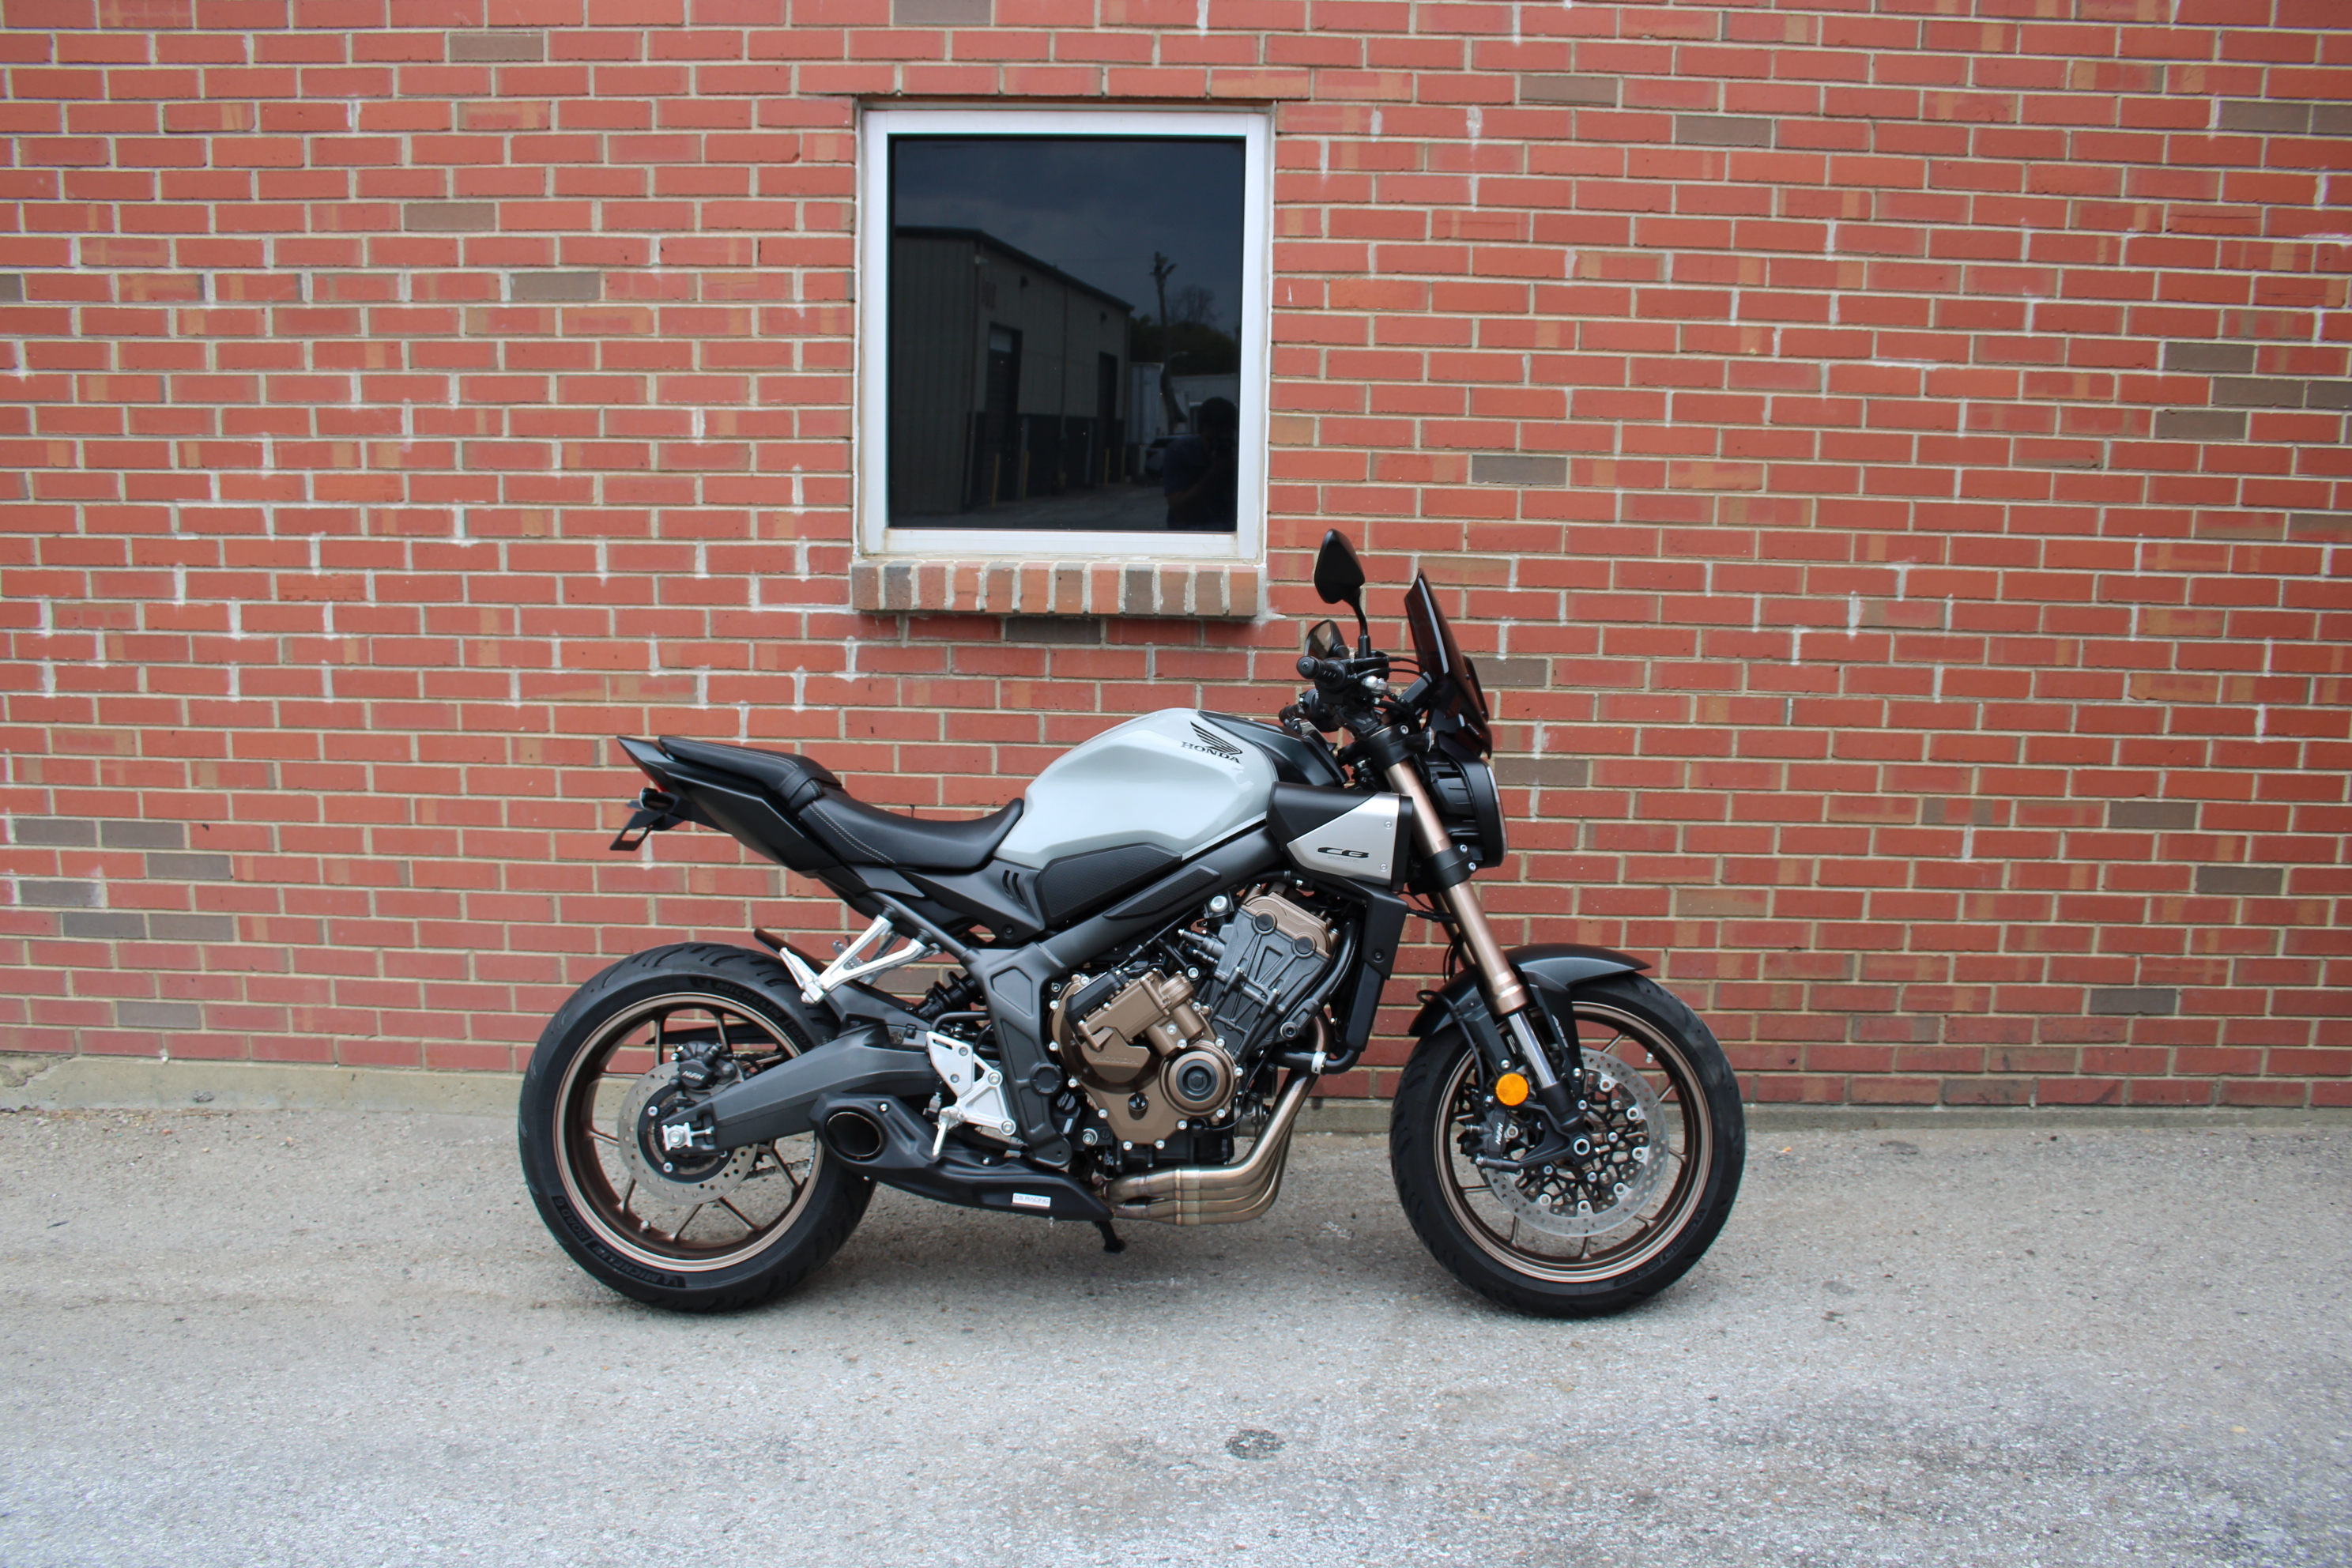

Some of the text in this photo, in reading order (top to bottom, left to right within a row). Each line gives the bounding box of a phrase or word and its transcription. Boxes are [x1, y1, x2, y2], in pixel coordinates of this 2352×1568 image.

[1181, 741, 1242, 764] HONDA
[1317, 846, 1370, 858] CB
[715, 981, 782, 1019] MICHELIN
[560, 1208, 590, 1239] ROAD
[592, 1244, 662, 1283] MICHELIN
